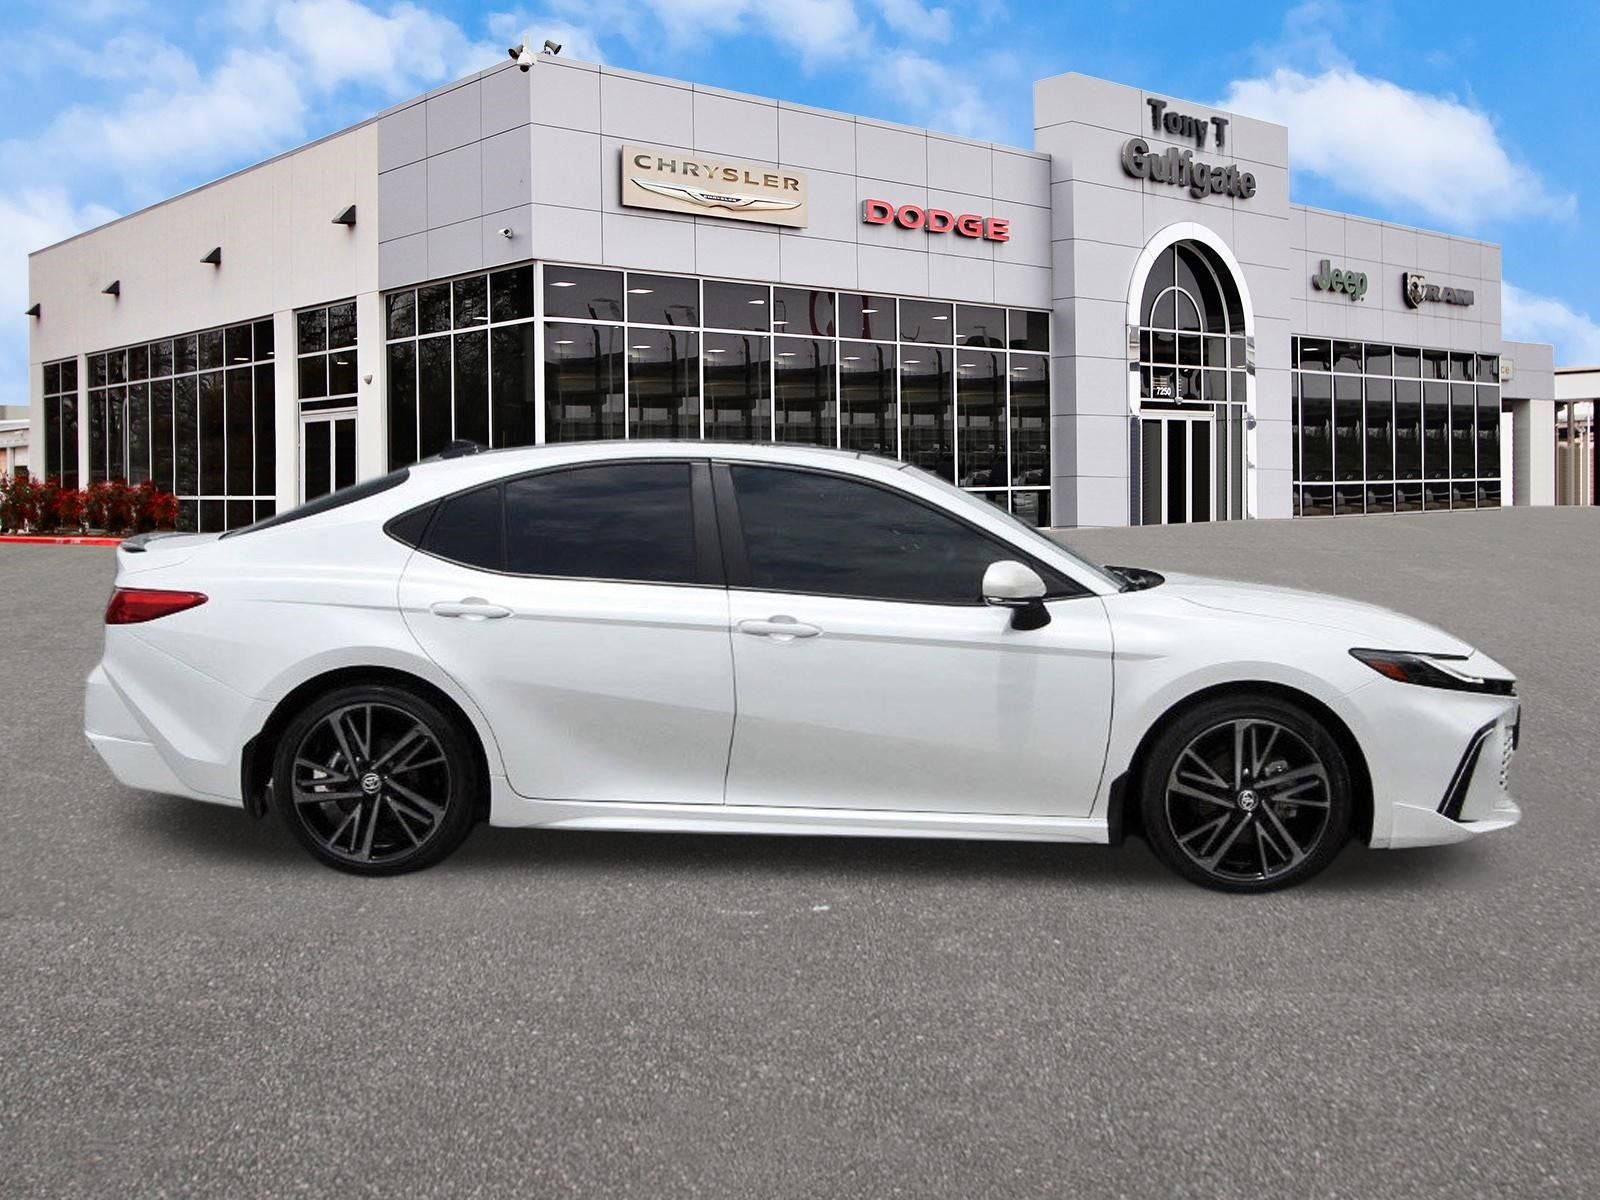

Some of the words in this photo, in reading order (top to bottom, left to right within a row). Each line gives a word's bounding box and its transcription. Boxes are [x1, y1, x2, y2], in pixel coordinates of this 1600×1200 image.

[1147, 98, 1208, 147] Tony
[1210, 116, 1229, 147] T
[633, 154, 800, 192] CHRYSLER
[1121, 138, 1257, 199] Gulfgate
[862, 198, 1010, 242] DODGE
[1312, 259, 1368, 302] Jeep
[1425, 284, 1474, 307] RAM
[1156, 386, 1172, 396] 7250
